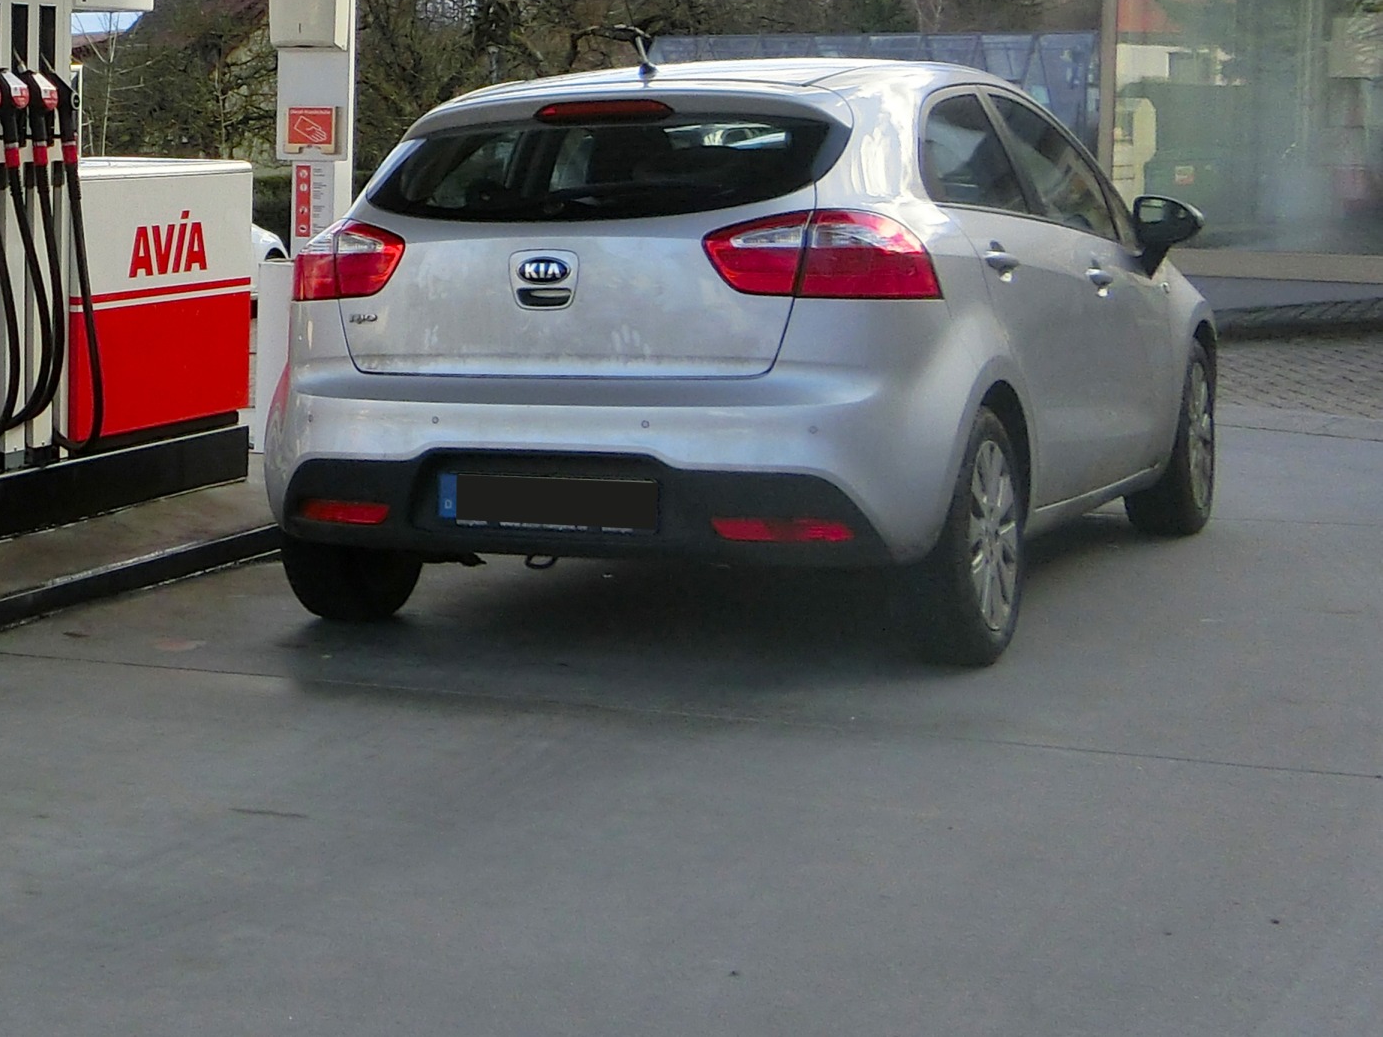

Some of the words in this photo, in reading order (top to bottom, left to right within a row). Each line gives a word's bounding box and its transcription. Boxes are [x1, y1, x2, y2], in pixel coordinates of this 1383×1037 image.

[129, 210, 208, 279] AVIA
[524, 262, 562, 279] KIA
[444, 499, 453, 509] D
